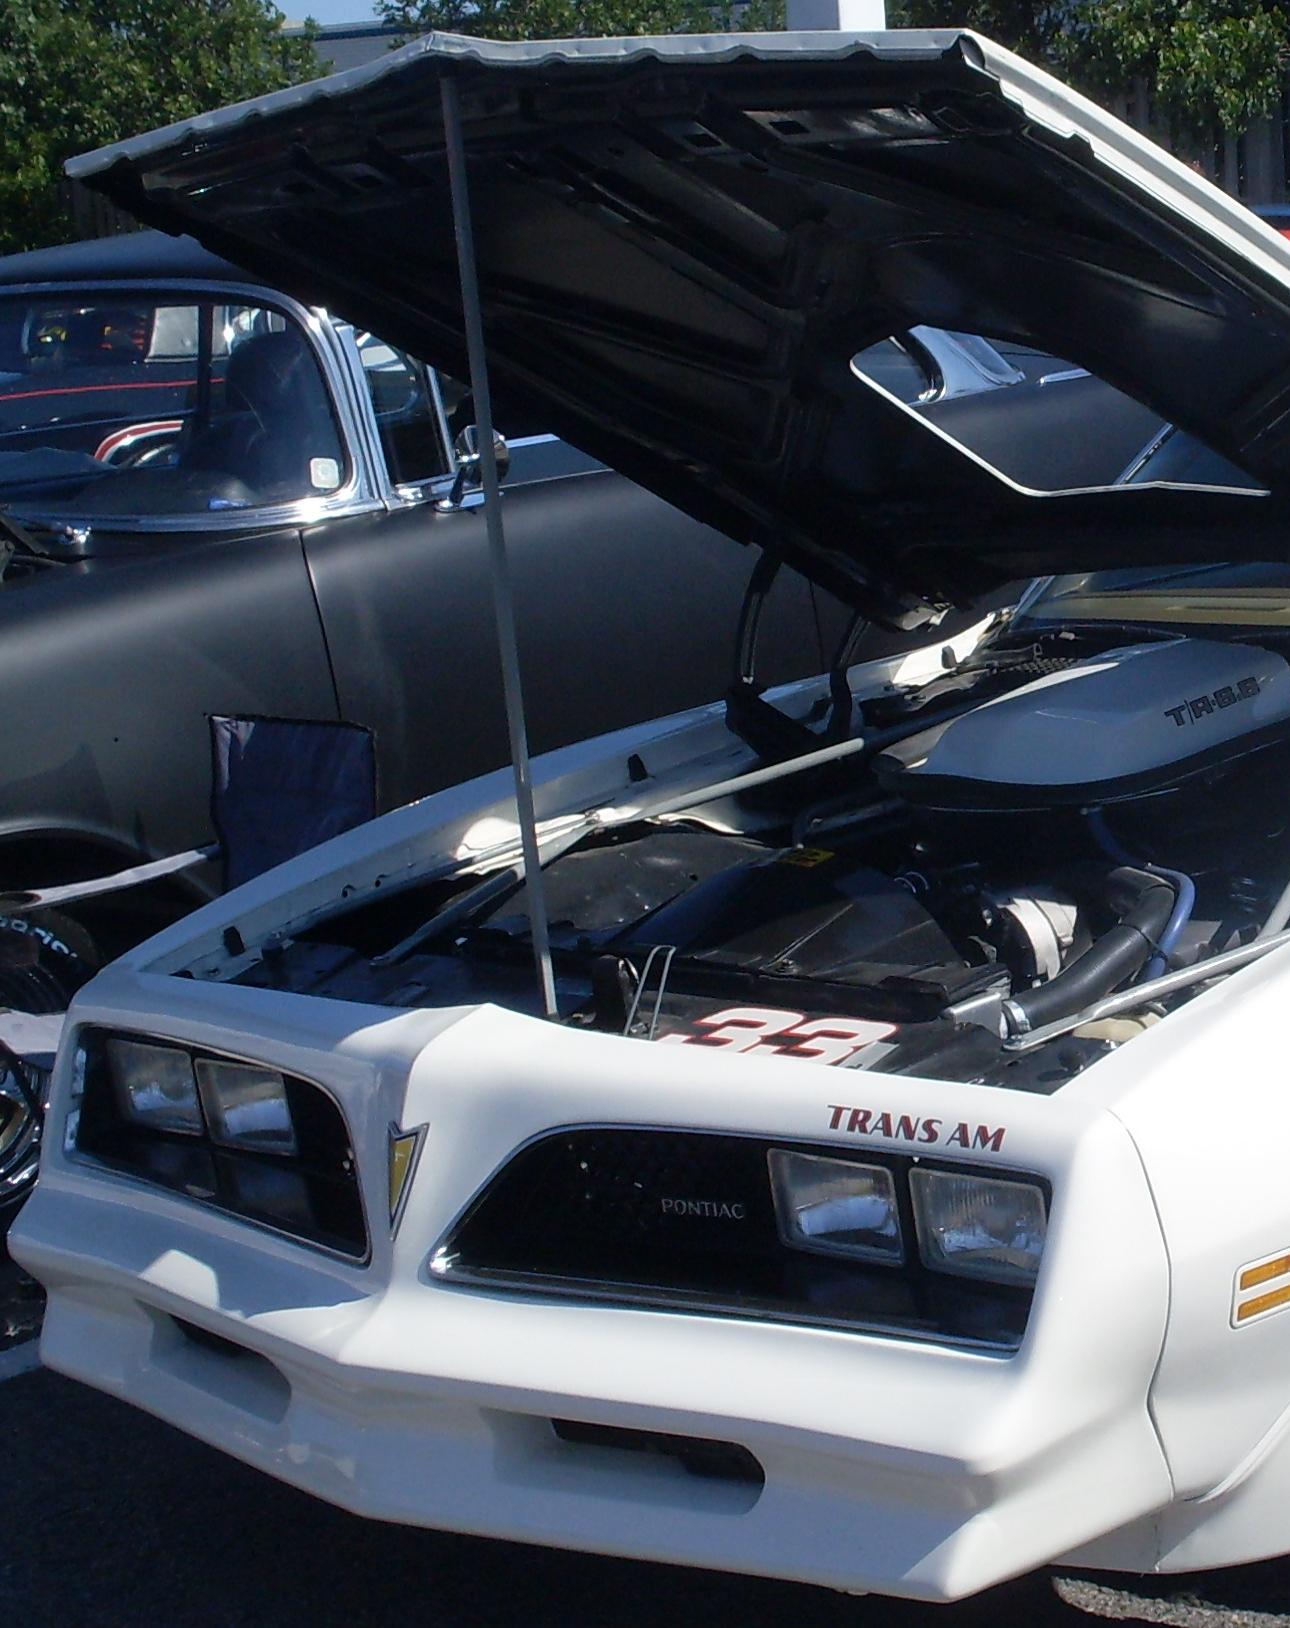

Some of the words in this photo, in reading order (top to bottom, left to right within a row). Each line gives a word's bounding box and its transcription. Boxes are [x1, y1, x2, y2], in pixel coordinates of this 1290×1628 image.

[827, 1105, 943, 1144] TRANS
[946, 1122, 1006, 1152] AM
[661, 1198, 744, 1219] PONTIAC
